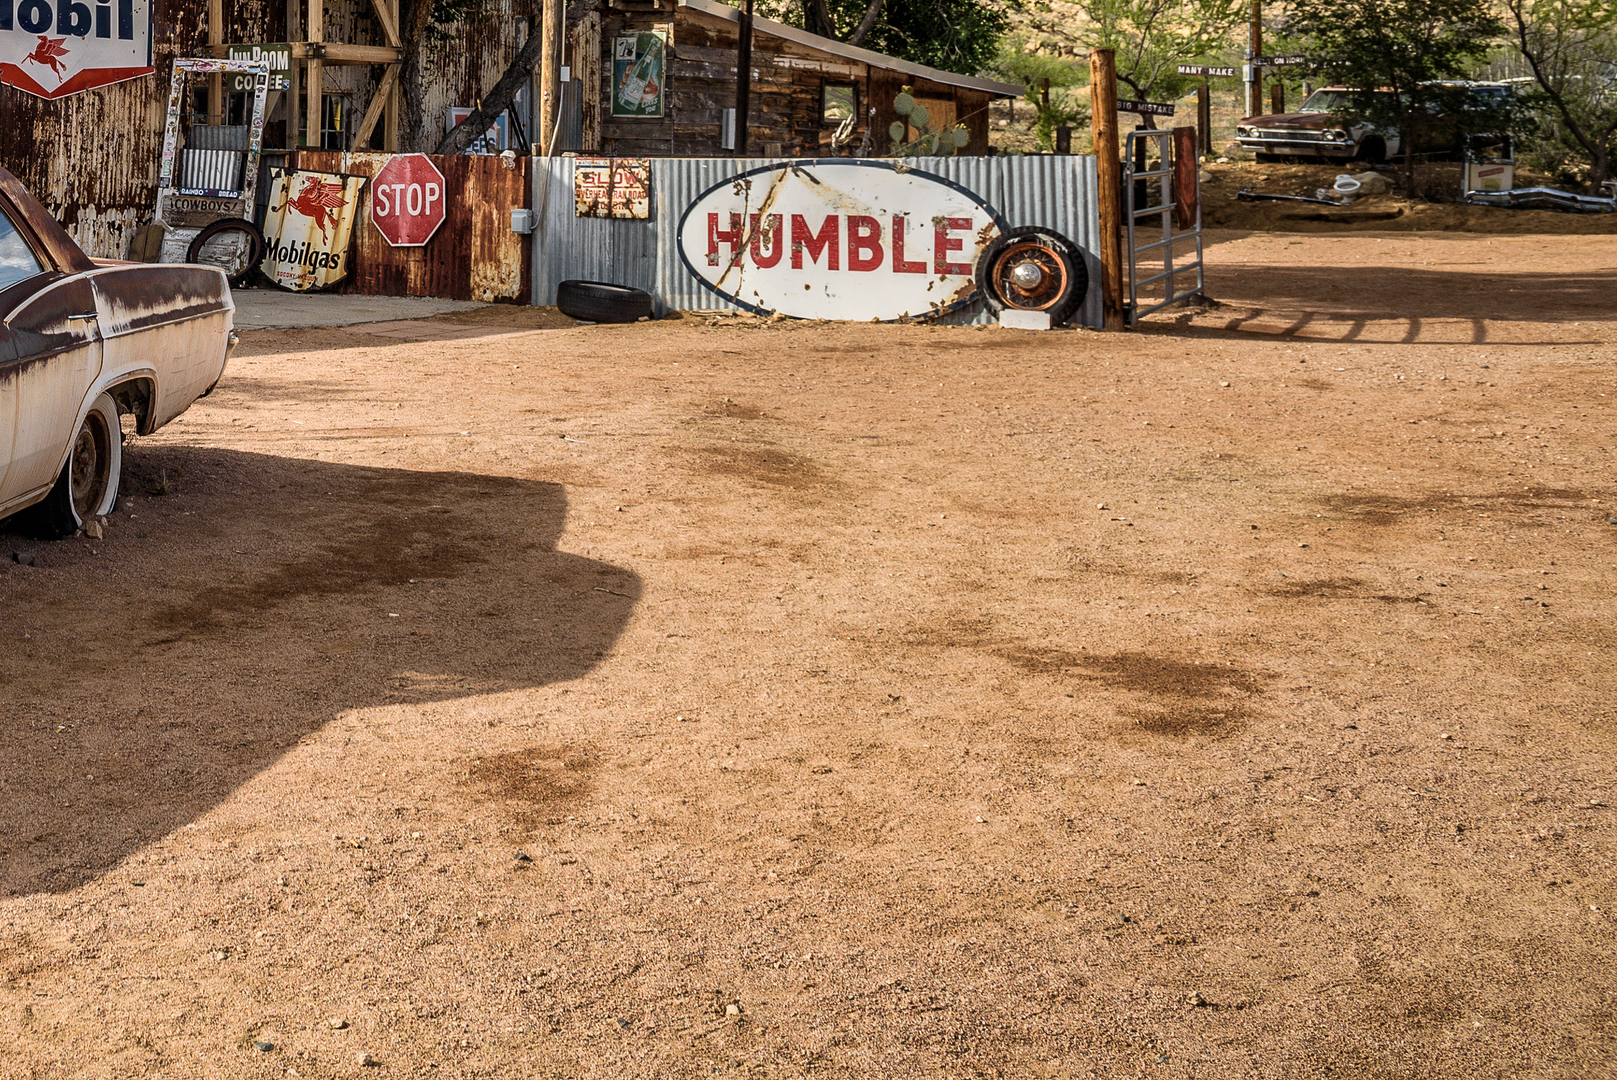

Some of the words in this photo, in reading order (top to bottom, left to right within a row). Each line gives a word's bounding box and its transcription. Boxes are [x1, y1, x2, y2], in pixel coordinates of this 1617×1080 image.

[252, 46, 289, 70] ROOM
[1177, 65, 1202, 75] MANY
[1208, 67, 1233, 76] MAKE
[234, 74, 283, 90] COEE
[1117, 101, 1132, 110] BIG
[1138, 103, 1174, 115] MISTAKE
[582, 171, 640, 185] SLOW
[218, 190, 237, 198] BREAD
[376, 182, 440, 216] STOP
[575, 189, 609, 199] OVERHEA
[707, 212, 973, 276] HUMBLE
[265, 236, 341, 276] Mobilgas
